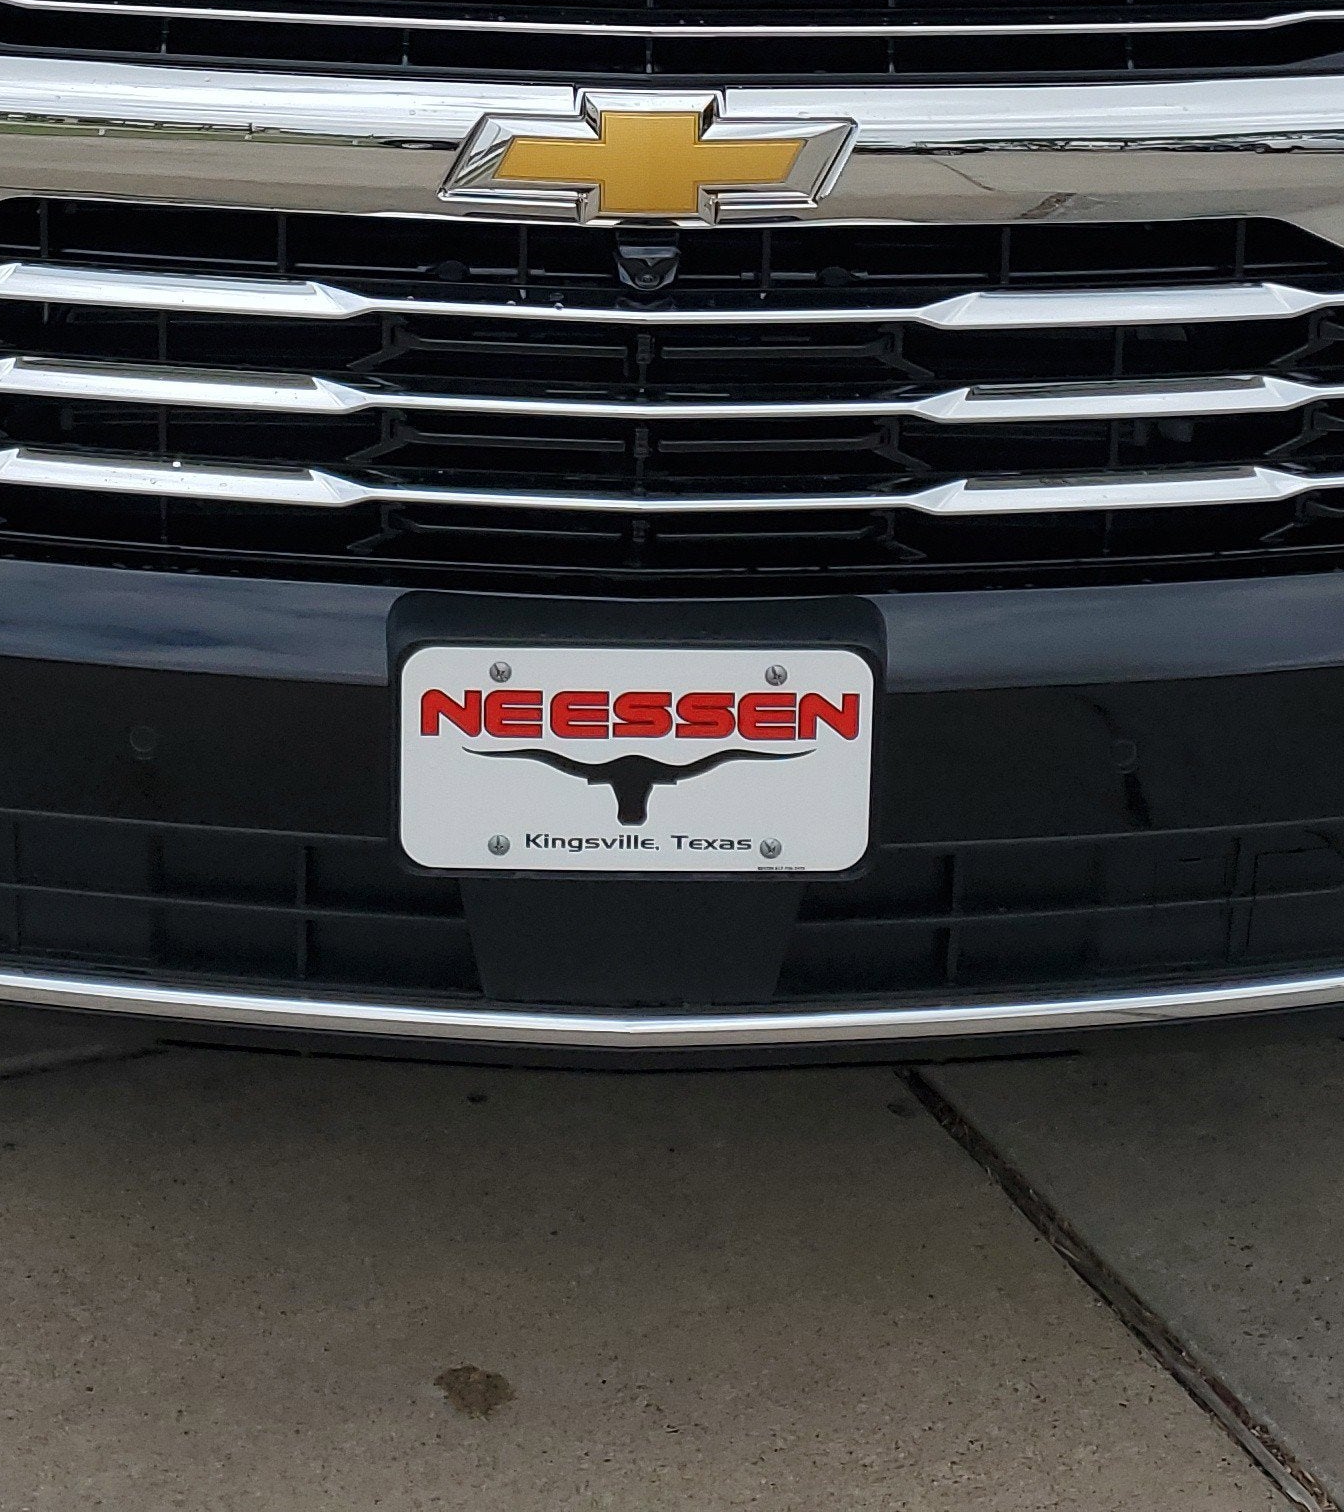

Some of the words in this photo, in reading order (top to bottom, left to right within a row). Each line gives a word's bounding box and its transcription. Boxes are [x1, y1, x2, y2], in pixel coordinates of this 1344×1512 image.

[420, 689, 860, 740] NEESSEN
[525, 833, 660, 852] Kingsville,
[671, 835, 752, 851] Texas
